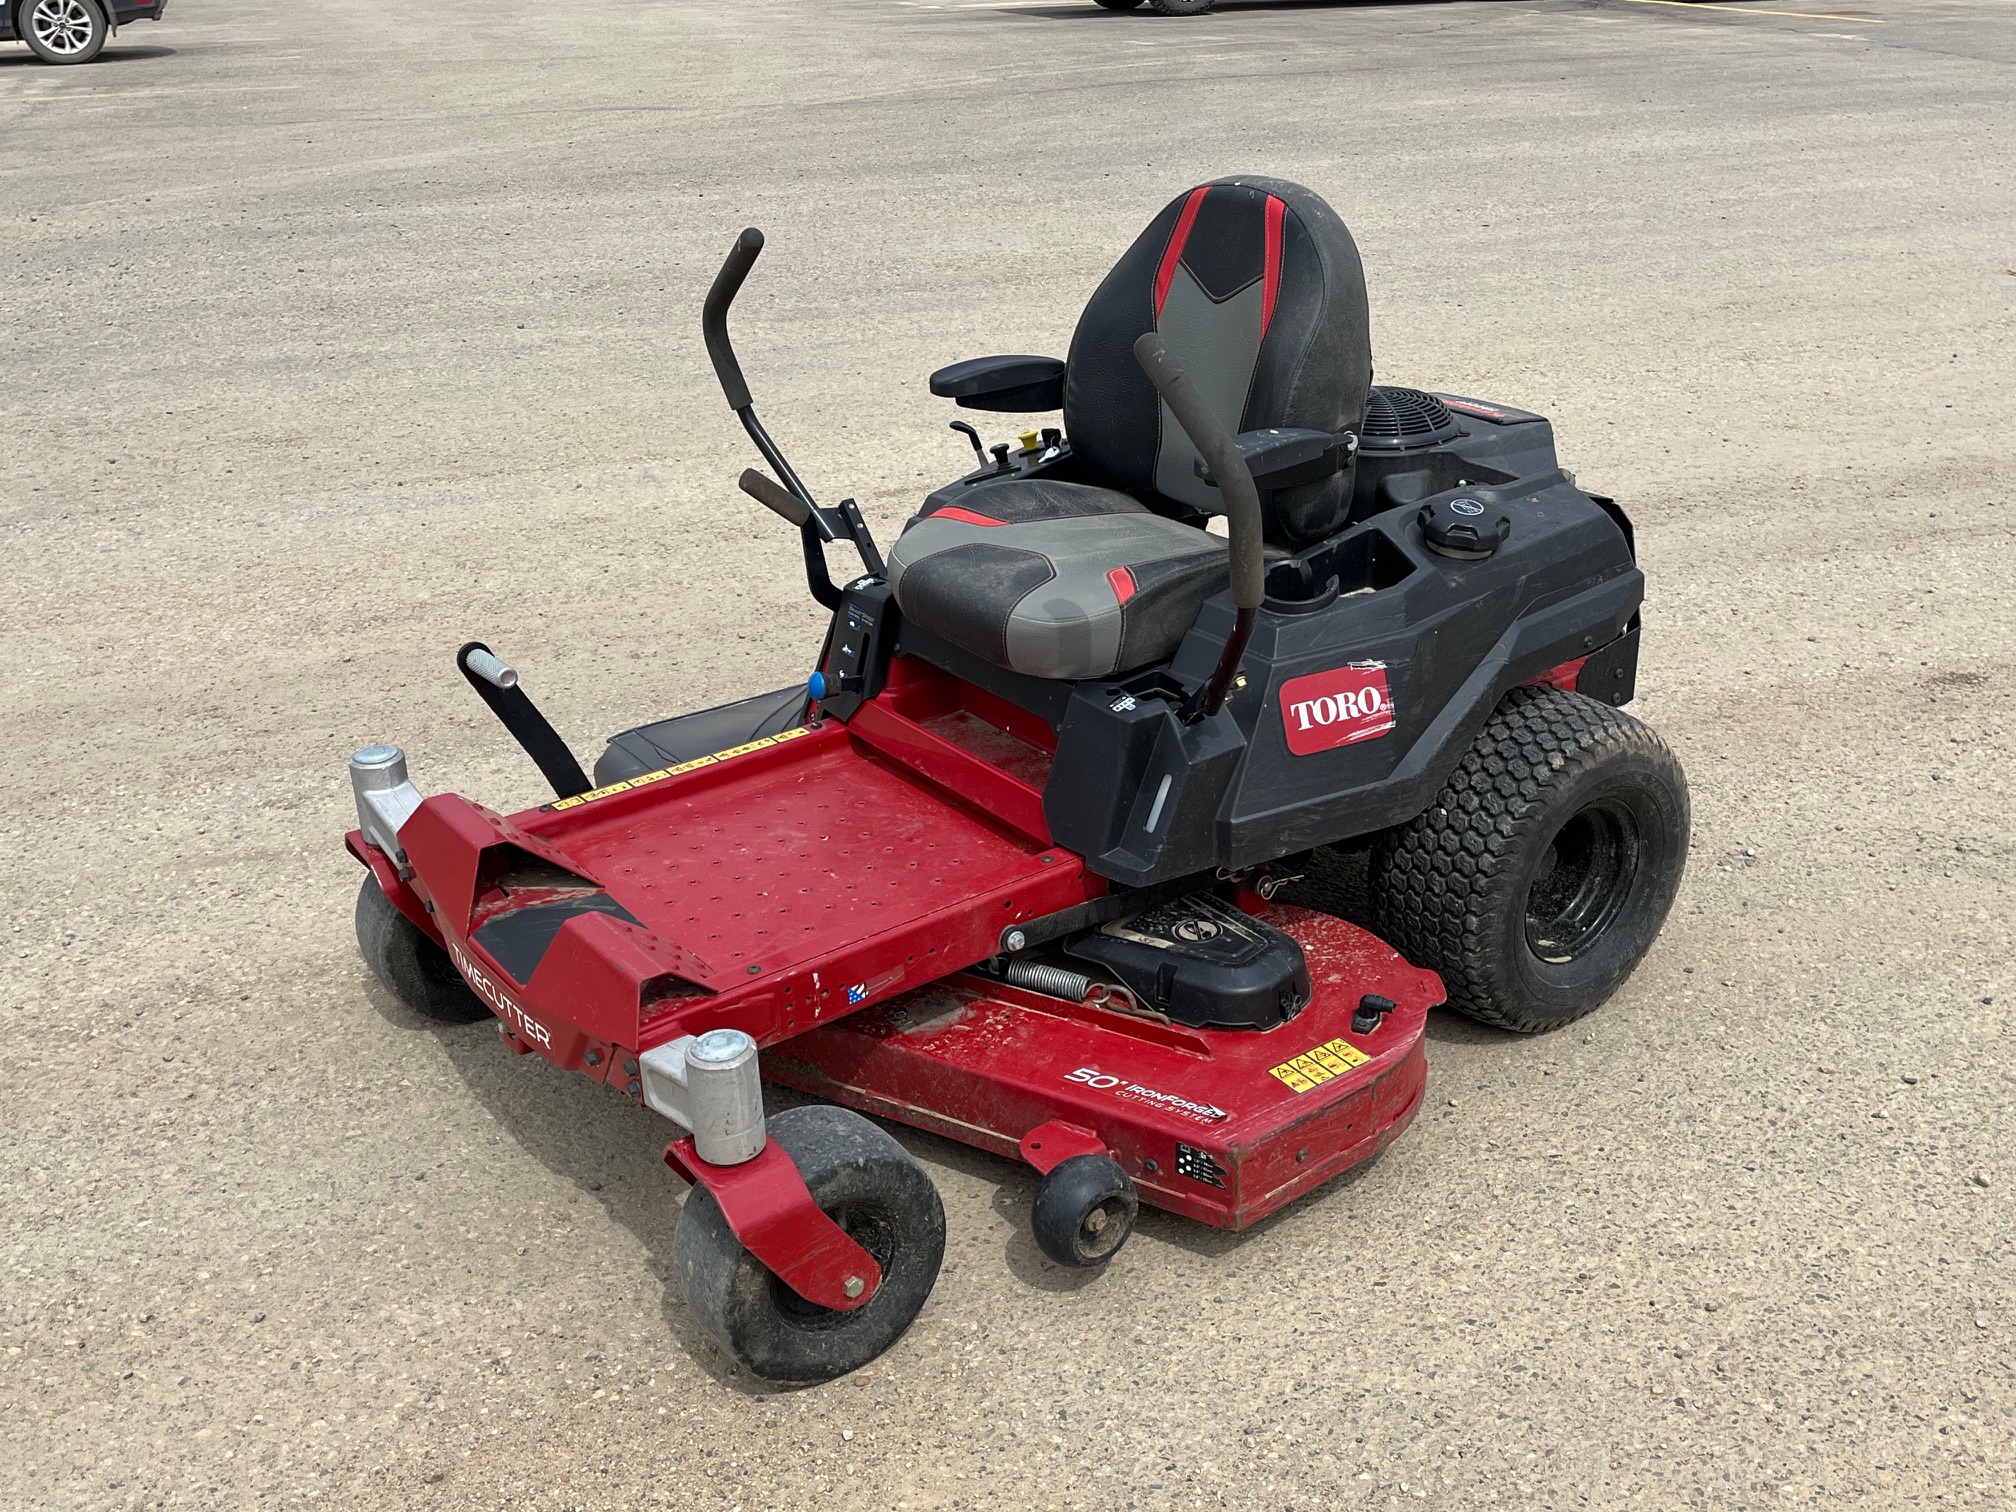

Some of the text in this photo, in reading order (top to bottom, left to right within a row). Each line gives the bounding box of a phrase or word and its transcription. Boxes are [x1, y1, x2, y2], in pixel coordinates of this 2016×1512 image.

[1290, 686, 1381, 731] TORO
[451, 942, 550, 1050] TIMECUTTER
[1115, 1090, 1213, 1124] CUTTING SYSTEM
